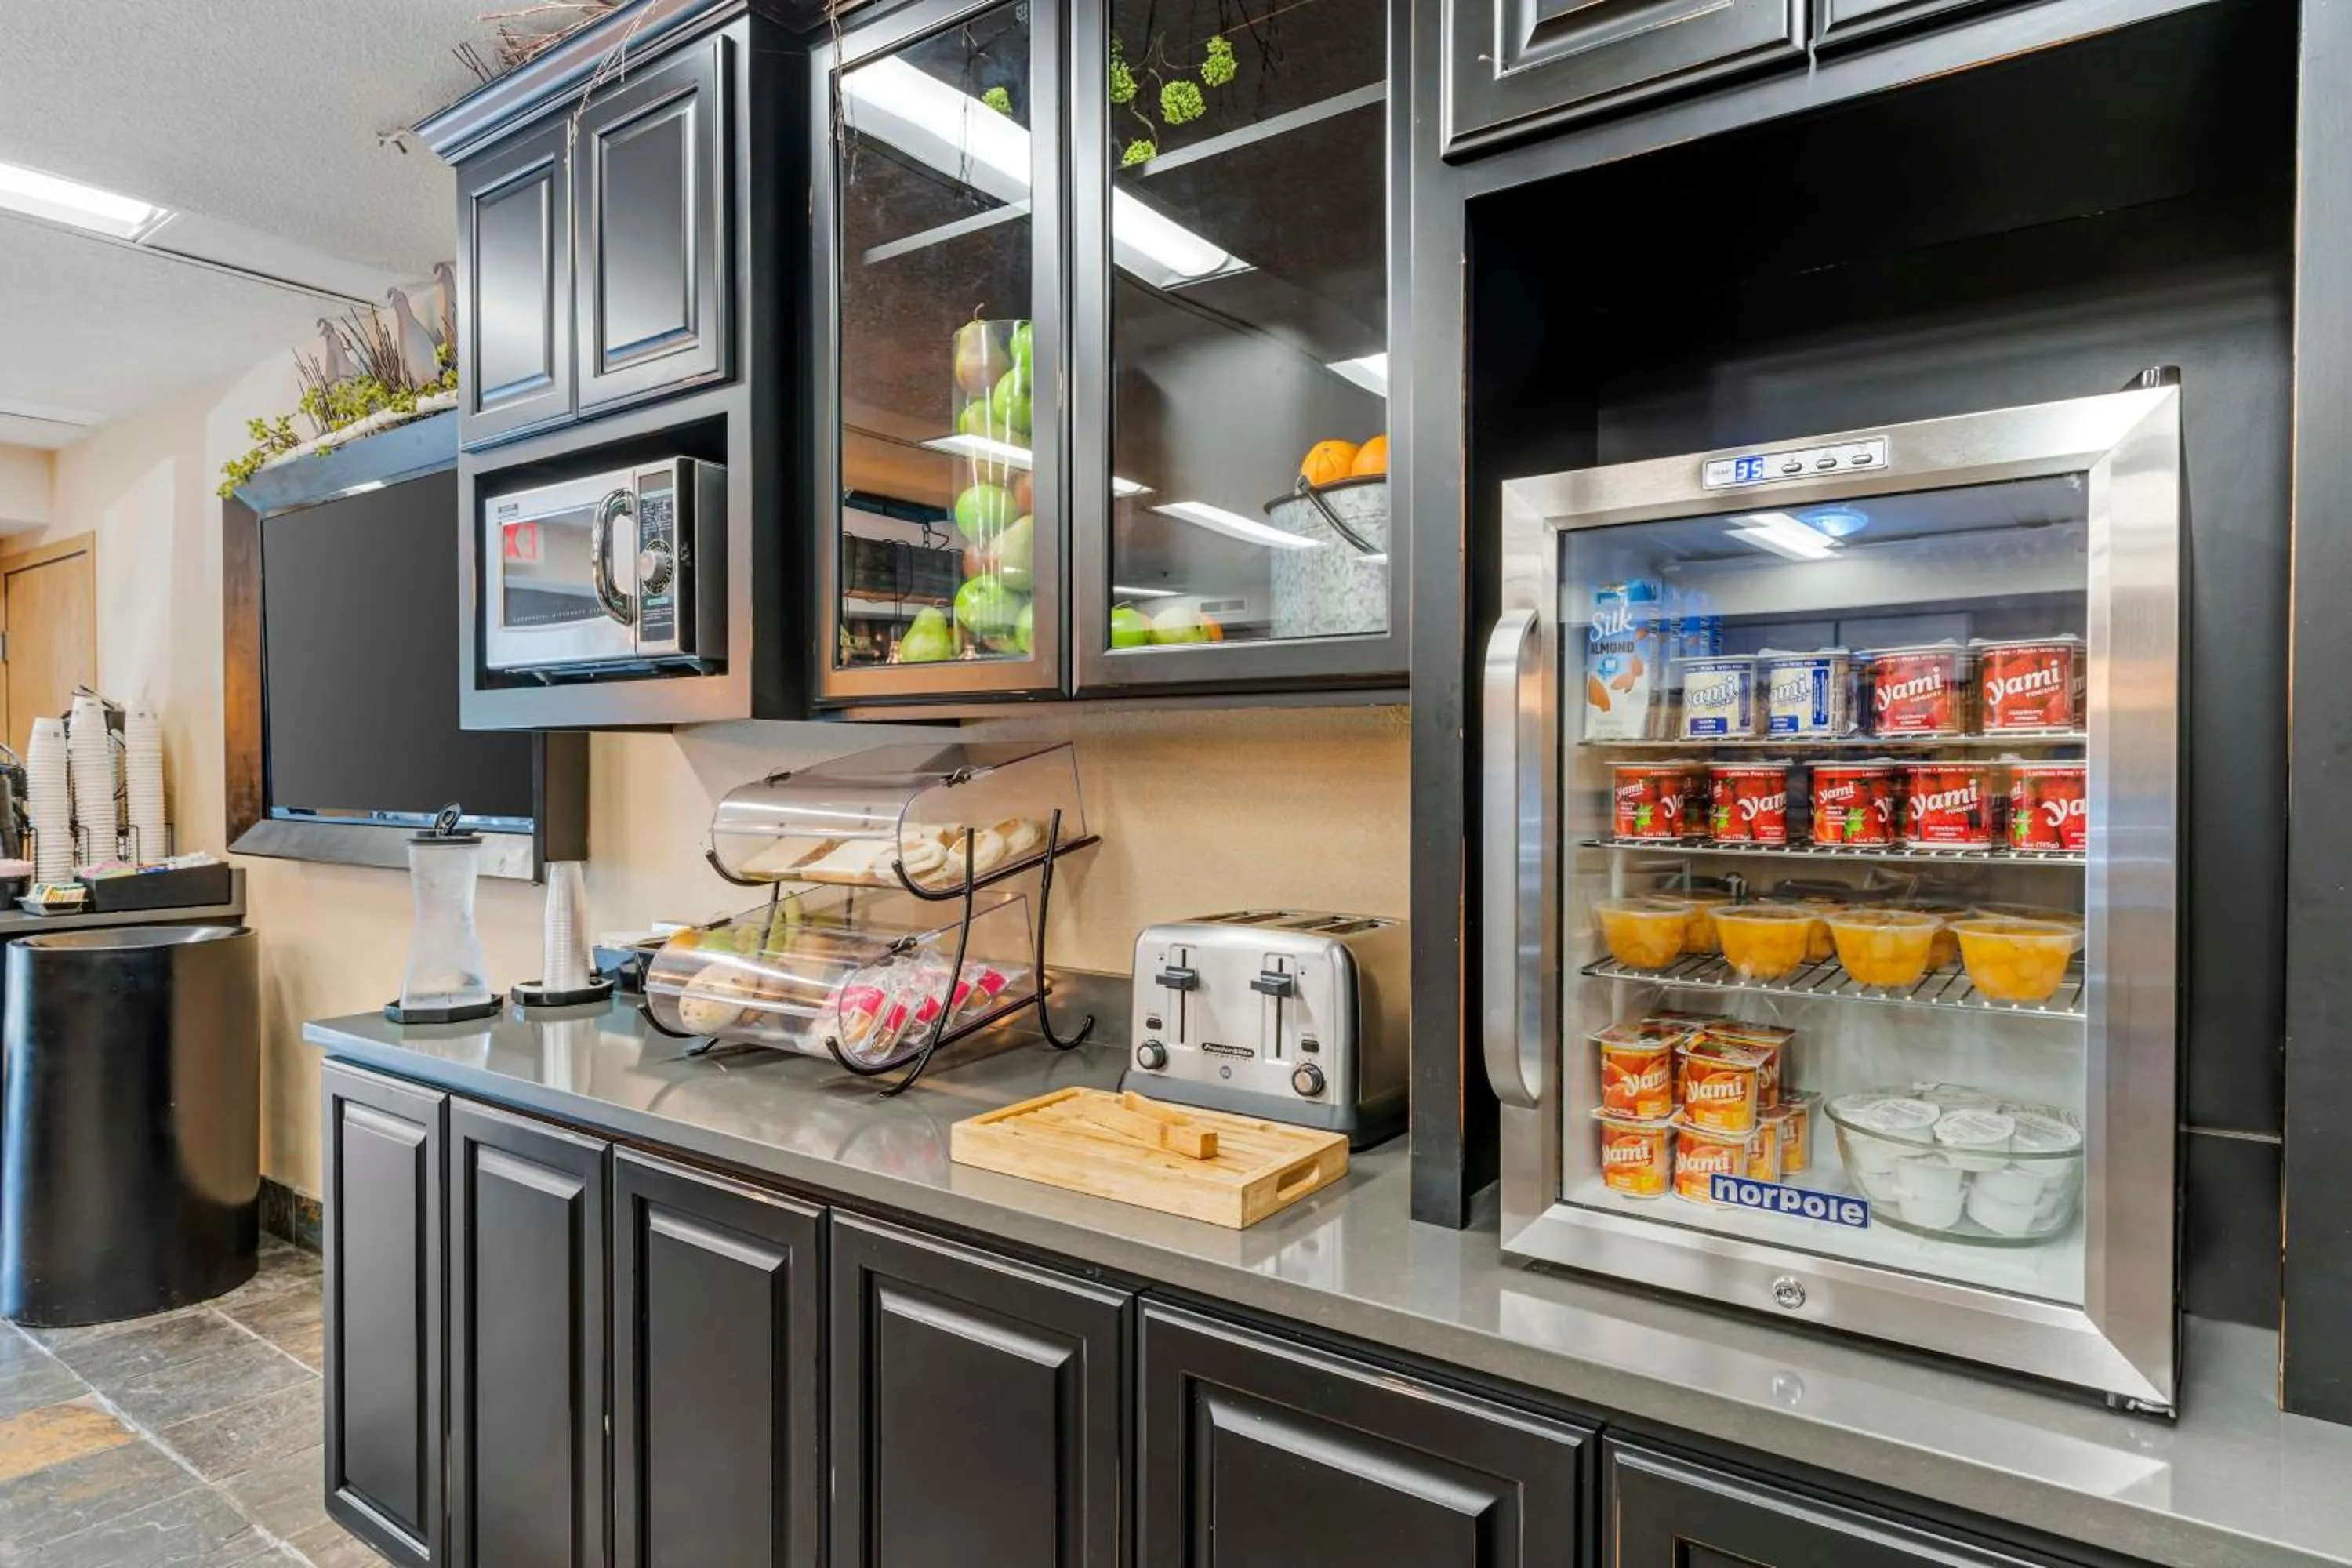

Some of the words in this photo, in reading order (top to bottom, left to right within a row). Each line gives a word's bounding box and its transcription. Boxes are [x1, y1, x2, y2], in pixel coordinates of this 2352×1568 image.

[1737, 459, 1762, 480] 35
[1589, 608, 1637, 641] Silk
[1591, 641, 1635, 655] ALMOND
[1715, 1177, 1865, 1226] norpole
